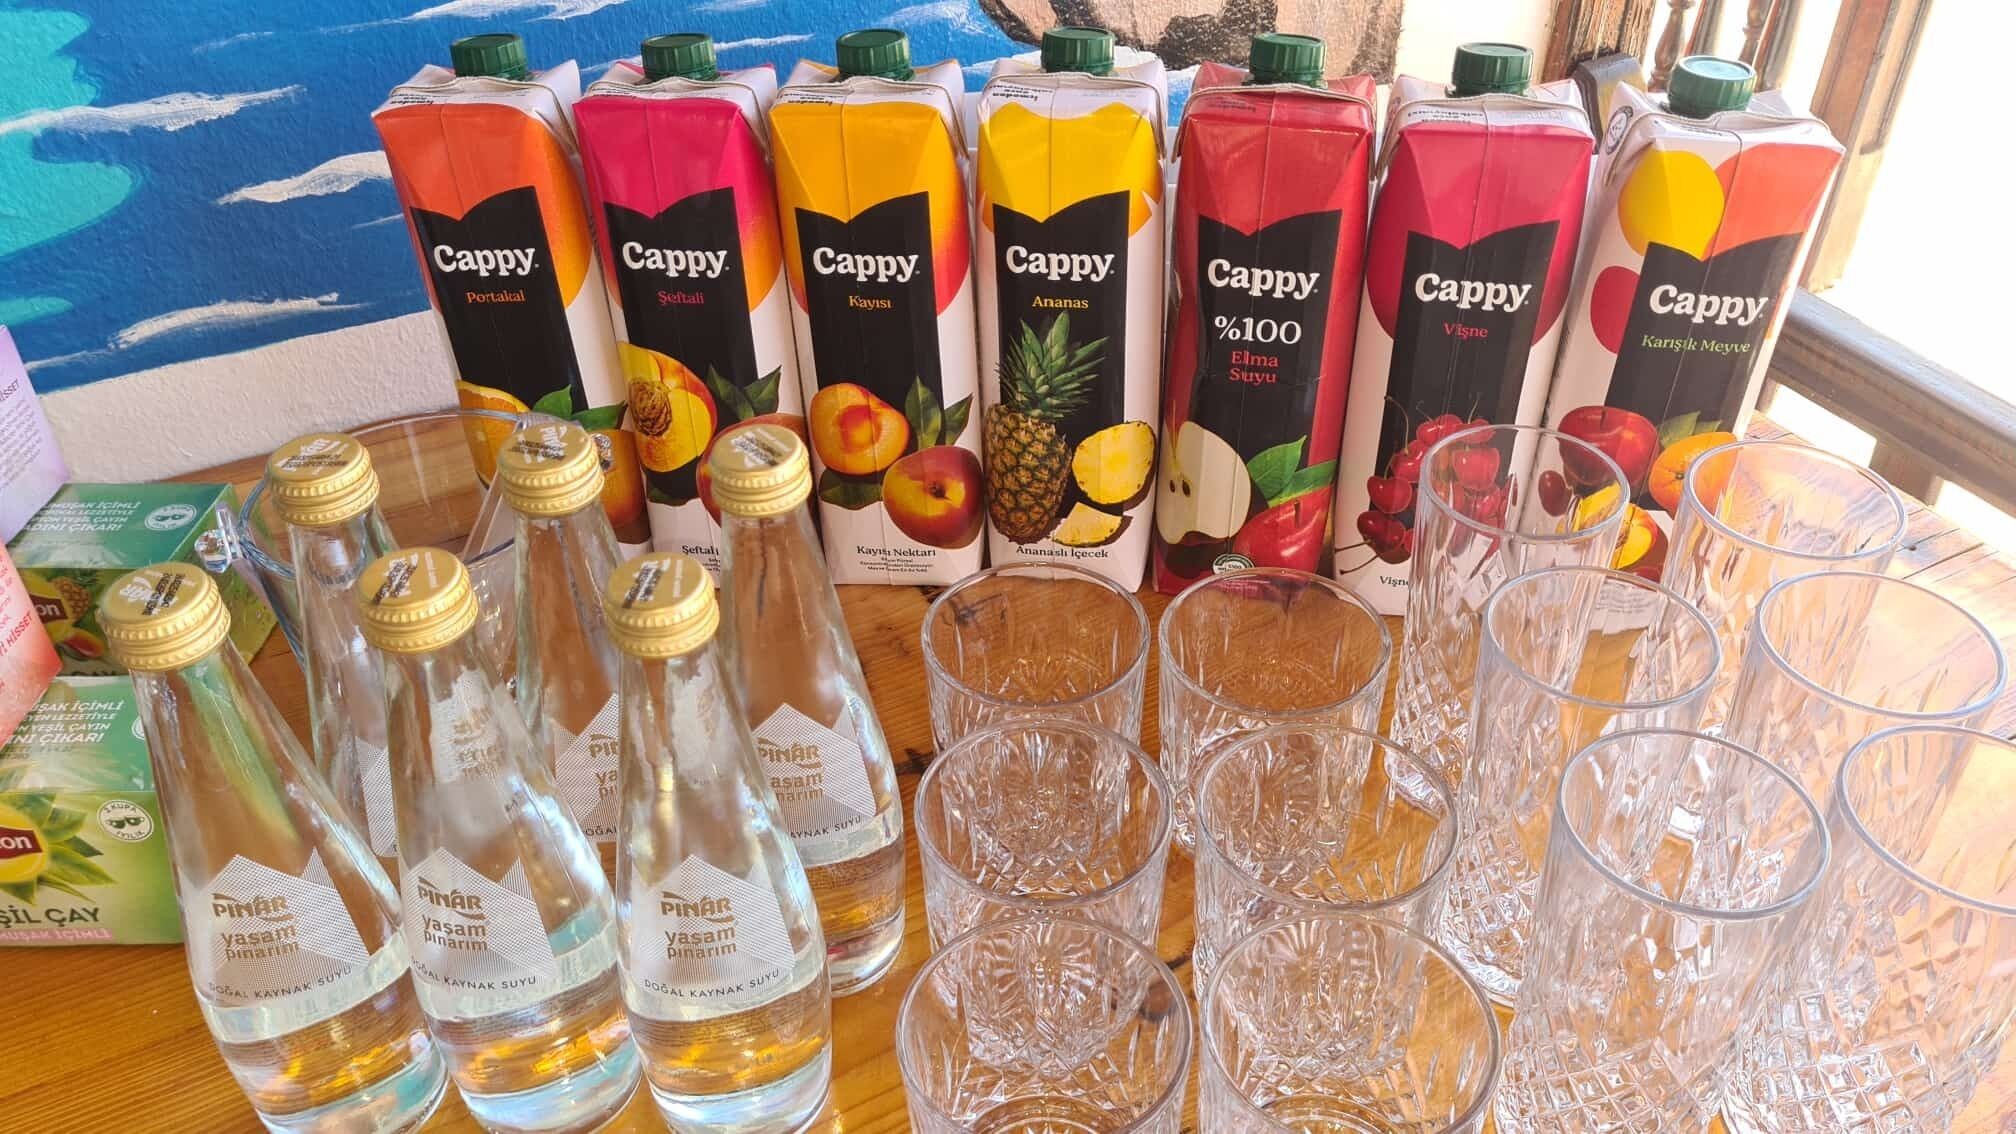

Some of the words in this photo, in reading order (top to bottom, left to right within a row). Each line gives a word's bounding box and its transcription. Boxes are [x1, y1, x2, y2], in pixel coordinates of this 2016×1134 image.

[434, 244, 536, 277] Cappy
[622, 241, 727, 277] Cappy
[813, 246, 919, 283] Cappy
[1006, 245, 1115, 282] Cappy
[1207, 258, 1321, 300] Cappy
[466, 290, 526, 304] Portakal
[657, 290, 705, 306] Şeftali
[848, 295, 893, 310] Kayısı
[1032, 295, 1089, 309] Ananas
[1415, 273, 1532, 313] Cappy
[1649, 284, 1768, 326] Cappy
[1214, 316, 1302, 345] %100
[1442, 322, 1488, 340] Vişne
[1641, 334, 1697, 353] Karışık
[1700, 338, 1751, 355] Meyve
[1231, 351, 1279, 367] Elma
[1229, 367, 1277, 386] Suyu
[893, 547, 936, 557] Nektarı
[1016, 545, 1067, 557] Ananaslı
[71, 700, 125, 713] İÇİMLİ
[70, 723, 111, 733] ÇAYIN
[834, 816, 861, 832] SUYU
[45, 907, 99, 928] ÇAY
[254, 983, 312, 999] KAYNAK
[317, 965, 352, 987] SUYU
[444, 976, 496, 990] KAYNAK
[501, 976, 536, 989] SUYU
[644, 979, 685, 998] DOĞAL
[690, 983, 744, 998] KAYNAK
[749, 967, 780, 989] SUYU
